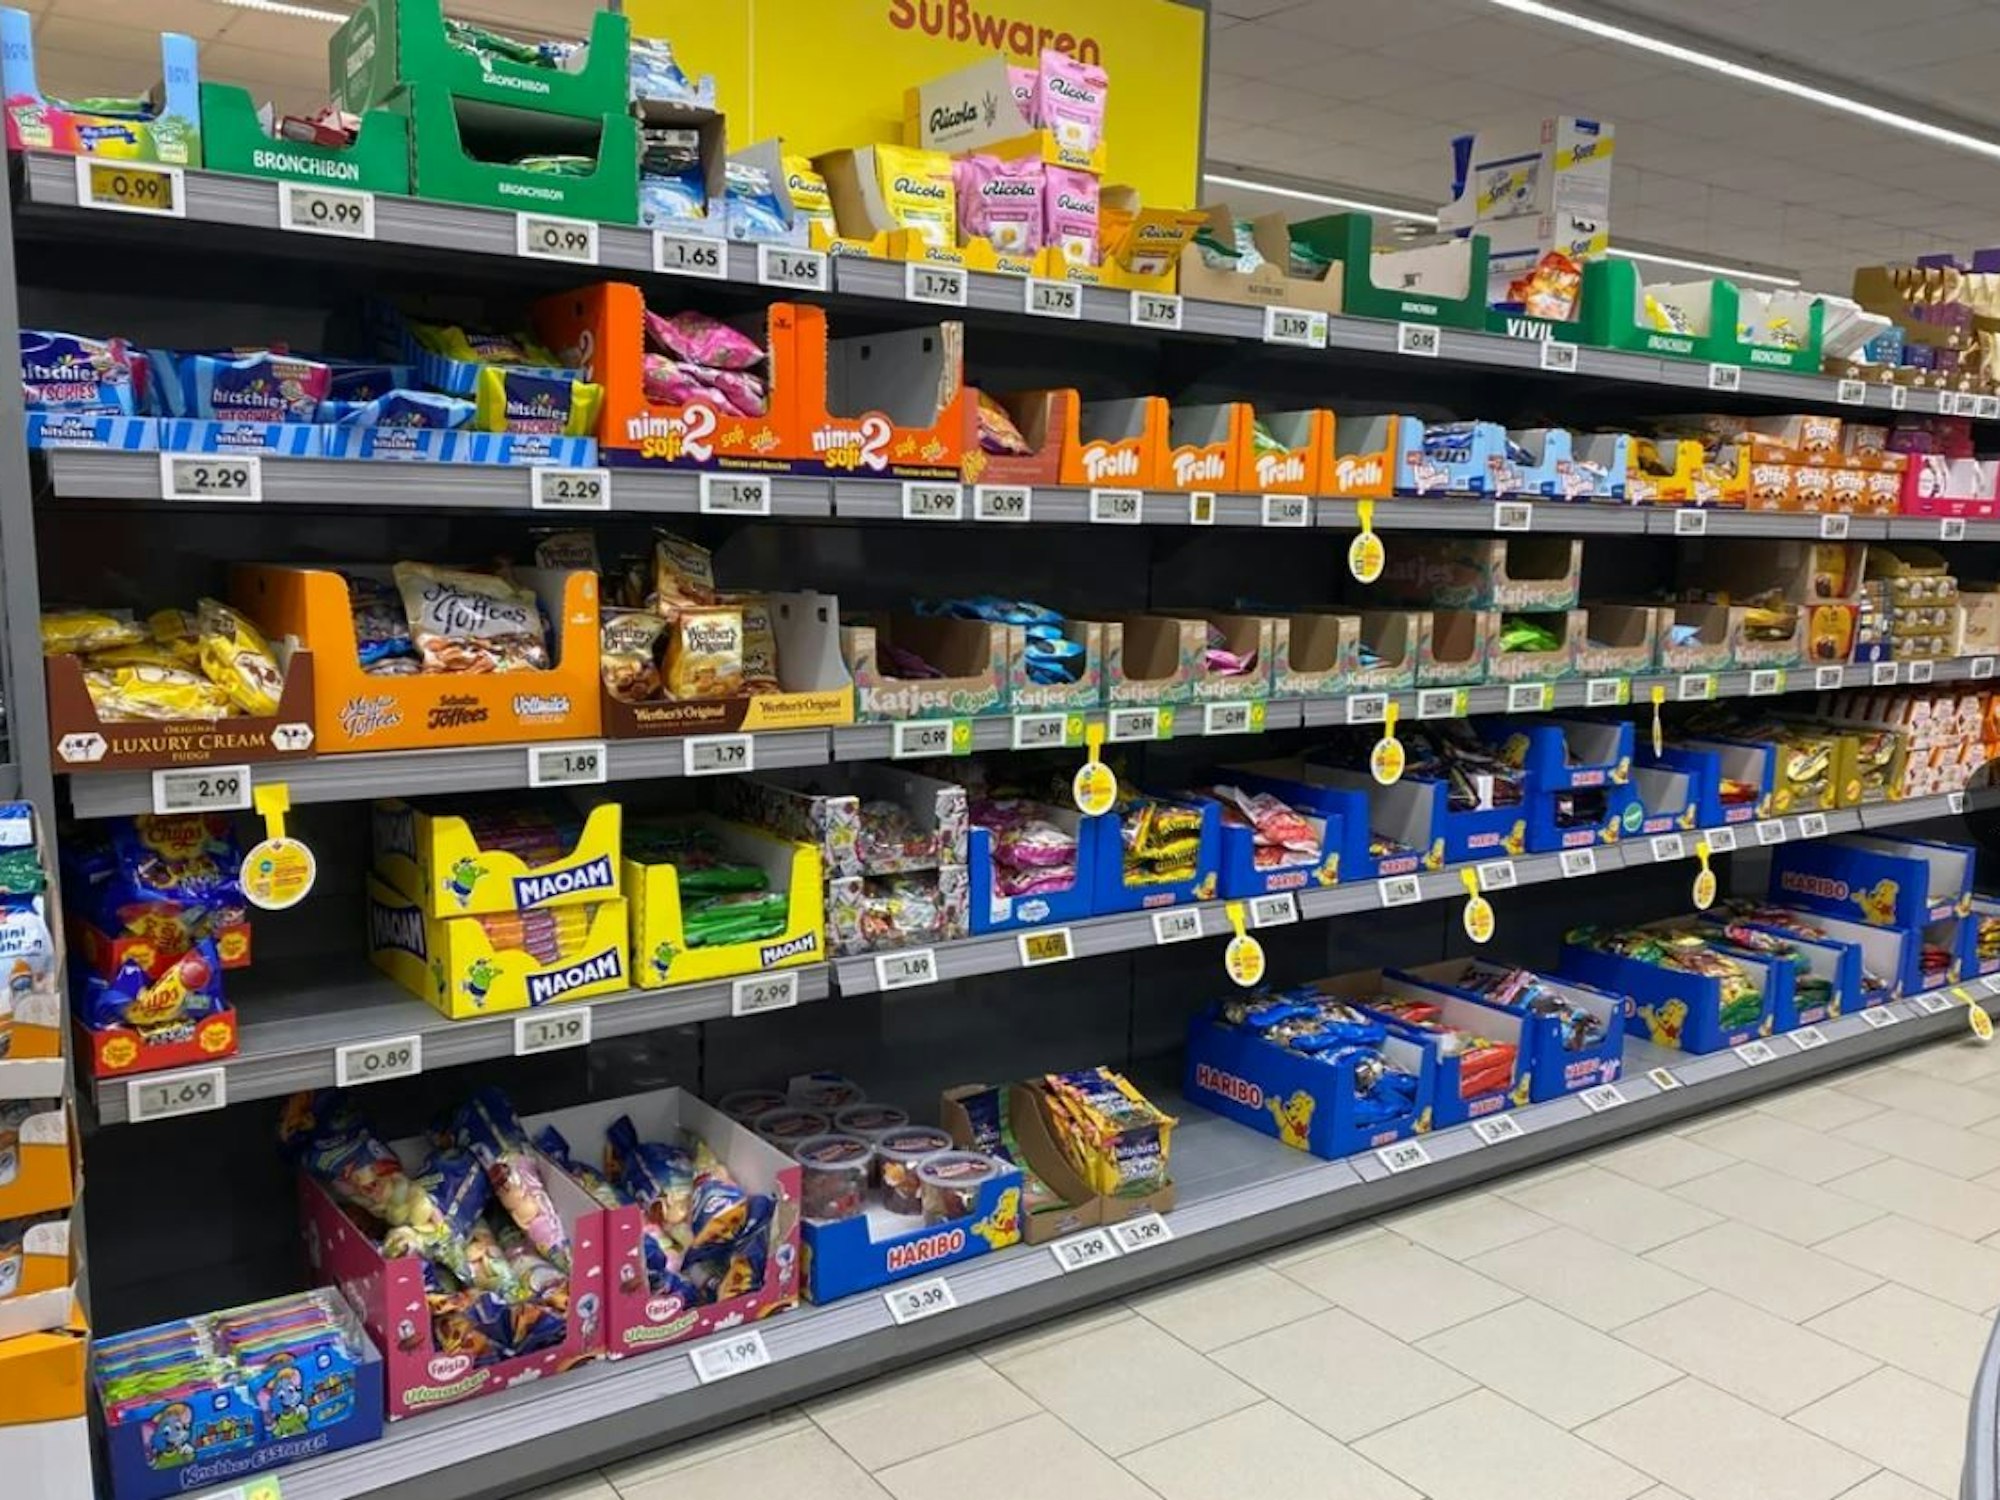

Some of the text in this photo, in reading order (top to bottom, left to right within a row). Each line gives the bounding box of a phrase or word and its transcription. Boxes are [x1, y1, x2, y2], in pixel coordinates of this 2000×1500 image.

[1050, 79, 1096, 102] Ricola
[930, 102, 978, 133] Ricola
[253, 150, 359, 181] BRONCHIBON
[112, 176, 159, 198] 0.99
[894, 178, 945, 199] Ricola
[983, 180, 1035, 197] Ricola
[311, 201, 362, 224] 0.99
[1057, 195, 1095, 215] Ricola
[544, 231, 588, 251] 0.99
[677, 245, 717, 266] 1.65
[781, 259, 818, 279] 1.65
[925, 275, 959, 294] 1.75
[1045, 290, 1074, 308] 1.75
[1148, 302, 1176, 319] 1.75
[1507, 318, 1555, 341] VIVIL
[213, 388, 288, 409] hitschies
[507, 402, 568, 420] hitschies
[41, 425, 94, 438] hitschies
[1083, 446, 1139, 483] Trolli
[1173, 450, 1226, 487] Trolli
[1256, 454, 1305, 487] Trolli
[1335, 457, 1383, 491] Trolli
[194, 470, 247, 488] 2.29
[558, 481, 600, 498] 2.29
[732, 486, 761, 502] 1.99
[922, 495, 954, 511] 1.99
[993, 497, 1024, 511] 0.99
[1114, 499, 1136, 513] 1.09
[859, 687, 949, 712] Katjes
[1011, 689, 1067, 709] Katjes
[1110, 685, 1160, 702] Katjes
[1192, 682, 1241, 698] Katjes
[428, 708, 488, 728] Toffees
[686, 705, 725, 720] Original
[1038, 723, 1061, 736] 0.99
[1132, 718, 1153, 731] 0.99
[112, 733, 266, 754] LUXURY CREAM
[921, 731, 946, 745] 0.99
[172, 751, 210, 761] FUDGE
[716, 746, 745, 762] 1.79
[565, 756, 597, 773] 1.89
[199, 779, 239, 797] 2.99
[519, 861, 610, 906] MAOAM
[1782, 872, 1848, 900] HARIBO
[763, 935, 815, 963] MAOAM
[531, 953, 618, 1003] MAOAM
[754, 984, 790, 1003] 2.99
[540, 1020, 580, 1042] 1.19
[364, 1050, 410, 1071] 0.89
[160, 1082, 213, 1105] 1.69
[1196, 1064, 1263, 1110] HARIBO
[1131, 1223, 1160, 1241] 1.29
[887, 1230, 966, 1270] HARIBO
[1075, 1239, 1104, 1259] 1.29
[909, 1289, 943, 1308] 3.39
[725, 1342, 756, 1361] 1.99
